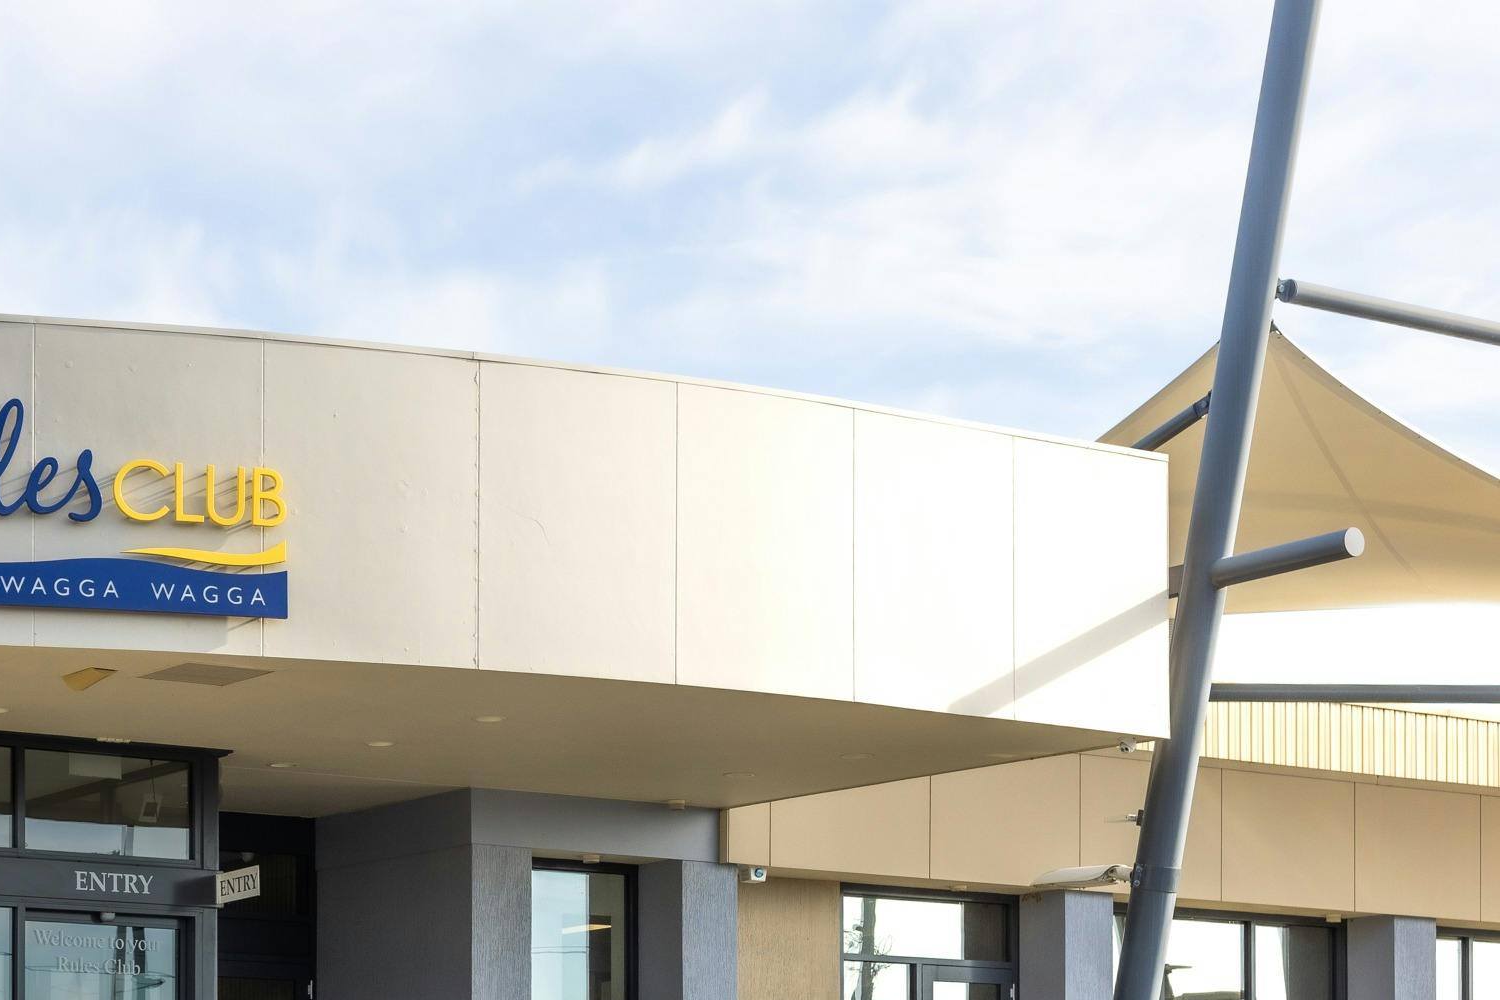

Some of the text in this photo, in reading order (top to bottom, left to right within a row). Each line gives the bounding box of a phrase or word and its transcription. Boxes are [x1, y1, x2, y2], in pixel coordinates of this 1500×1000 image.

[113, 458, 288, 528] CLUB
[0, 575, 266, 606] WAGGA WAGGA
[74, 870, 154, 895] ENTRY
[220, 872, 259, 898] ENTRY
[33, 927, 159, 954] Welcome to your
[57, 955, 141, 976] Rules Club
